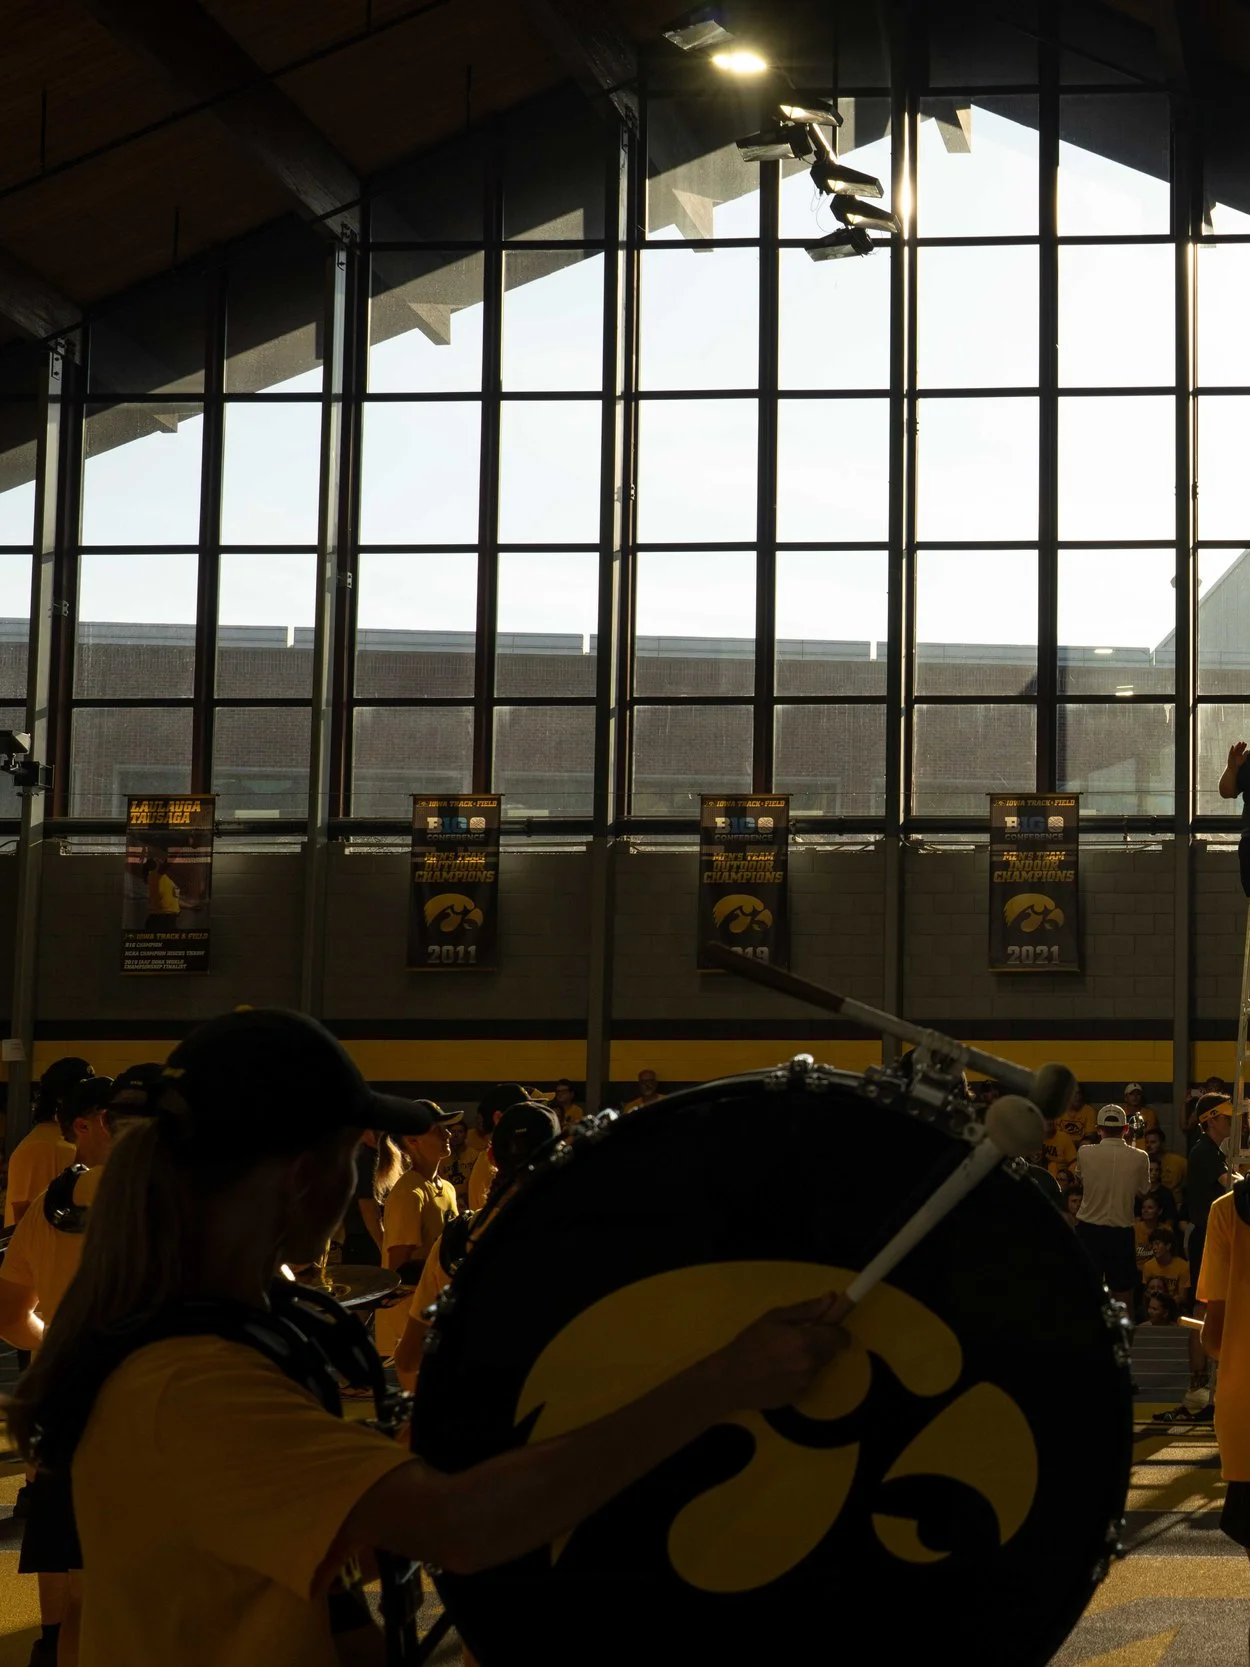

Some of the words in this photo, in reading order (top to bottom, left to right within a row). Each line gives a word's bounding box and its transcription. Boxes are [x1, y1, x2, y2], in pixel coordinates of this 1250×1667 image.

[130, 800, 202, 812] LAULAUGA
[1005, 799, 1026, 807] IOWA
[1027, 799, 1053, 807] TRACK
[1054, 799, 1076, 807] FIELD
[130, 812, 191, 824] TAUSAGA
[715, 834, 775, 842] CONFERENCE
[1005, 833, 1065, 841] CONFERENCE
[456, 852, 487, 862] TEAM
[746, 852, 776, 861] TEAM
[1036, 851, 1066, 861] TEAM
[424, 861, 487, 872] OUTDOOR
[712, 861, 776, 872] OUTDOOR
[1007, 860, 1060, 871] INDOOR
[414, 871, 497, 883] CHAMPIONS
[703, 871, 785, 883] CHAMPIONS
[993, 870, 1076, 882] CHAMPIONS
[157, 932, 180, 940] TRACK
[188, 932, 209, 940] FIELD
[427, 945, 478, 964] 2011
[731, 946, 770, 965] 19
[1007, 945, 1060, 964] 2021
